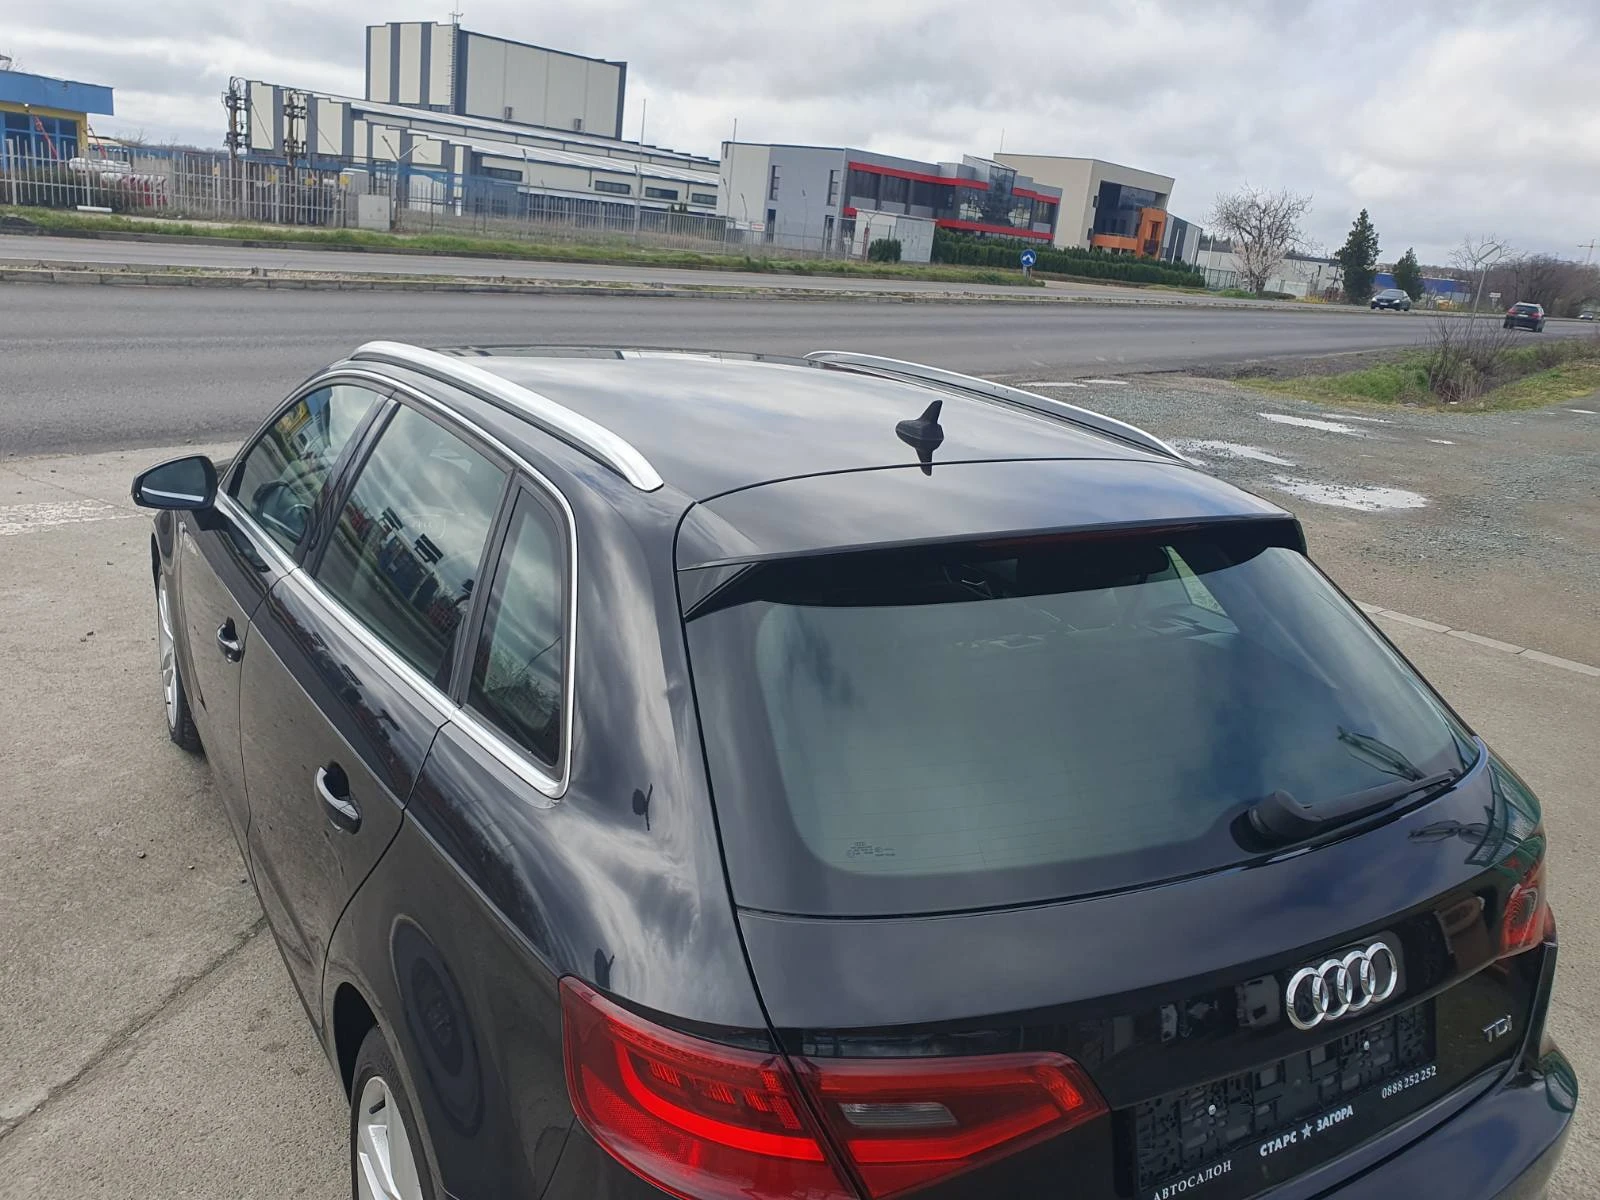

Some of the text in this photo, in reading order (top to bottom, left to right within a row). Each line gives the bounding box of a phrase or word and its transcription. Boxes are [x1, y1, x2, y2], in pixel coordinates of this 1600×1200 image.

[1153, 1065, 1436, 1200] АВТОСАЛОН СТАРС ЗАГОРА 0888 252 252
